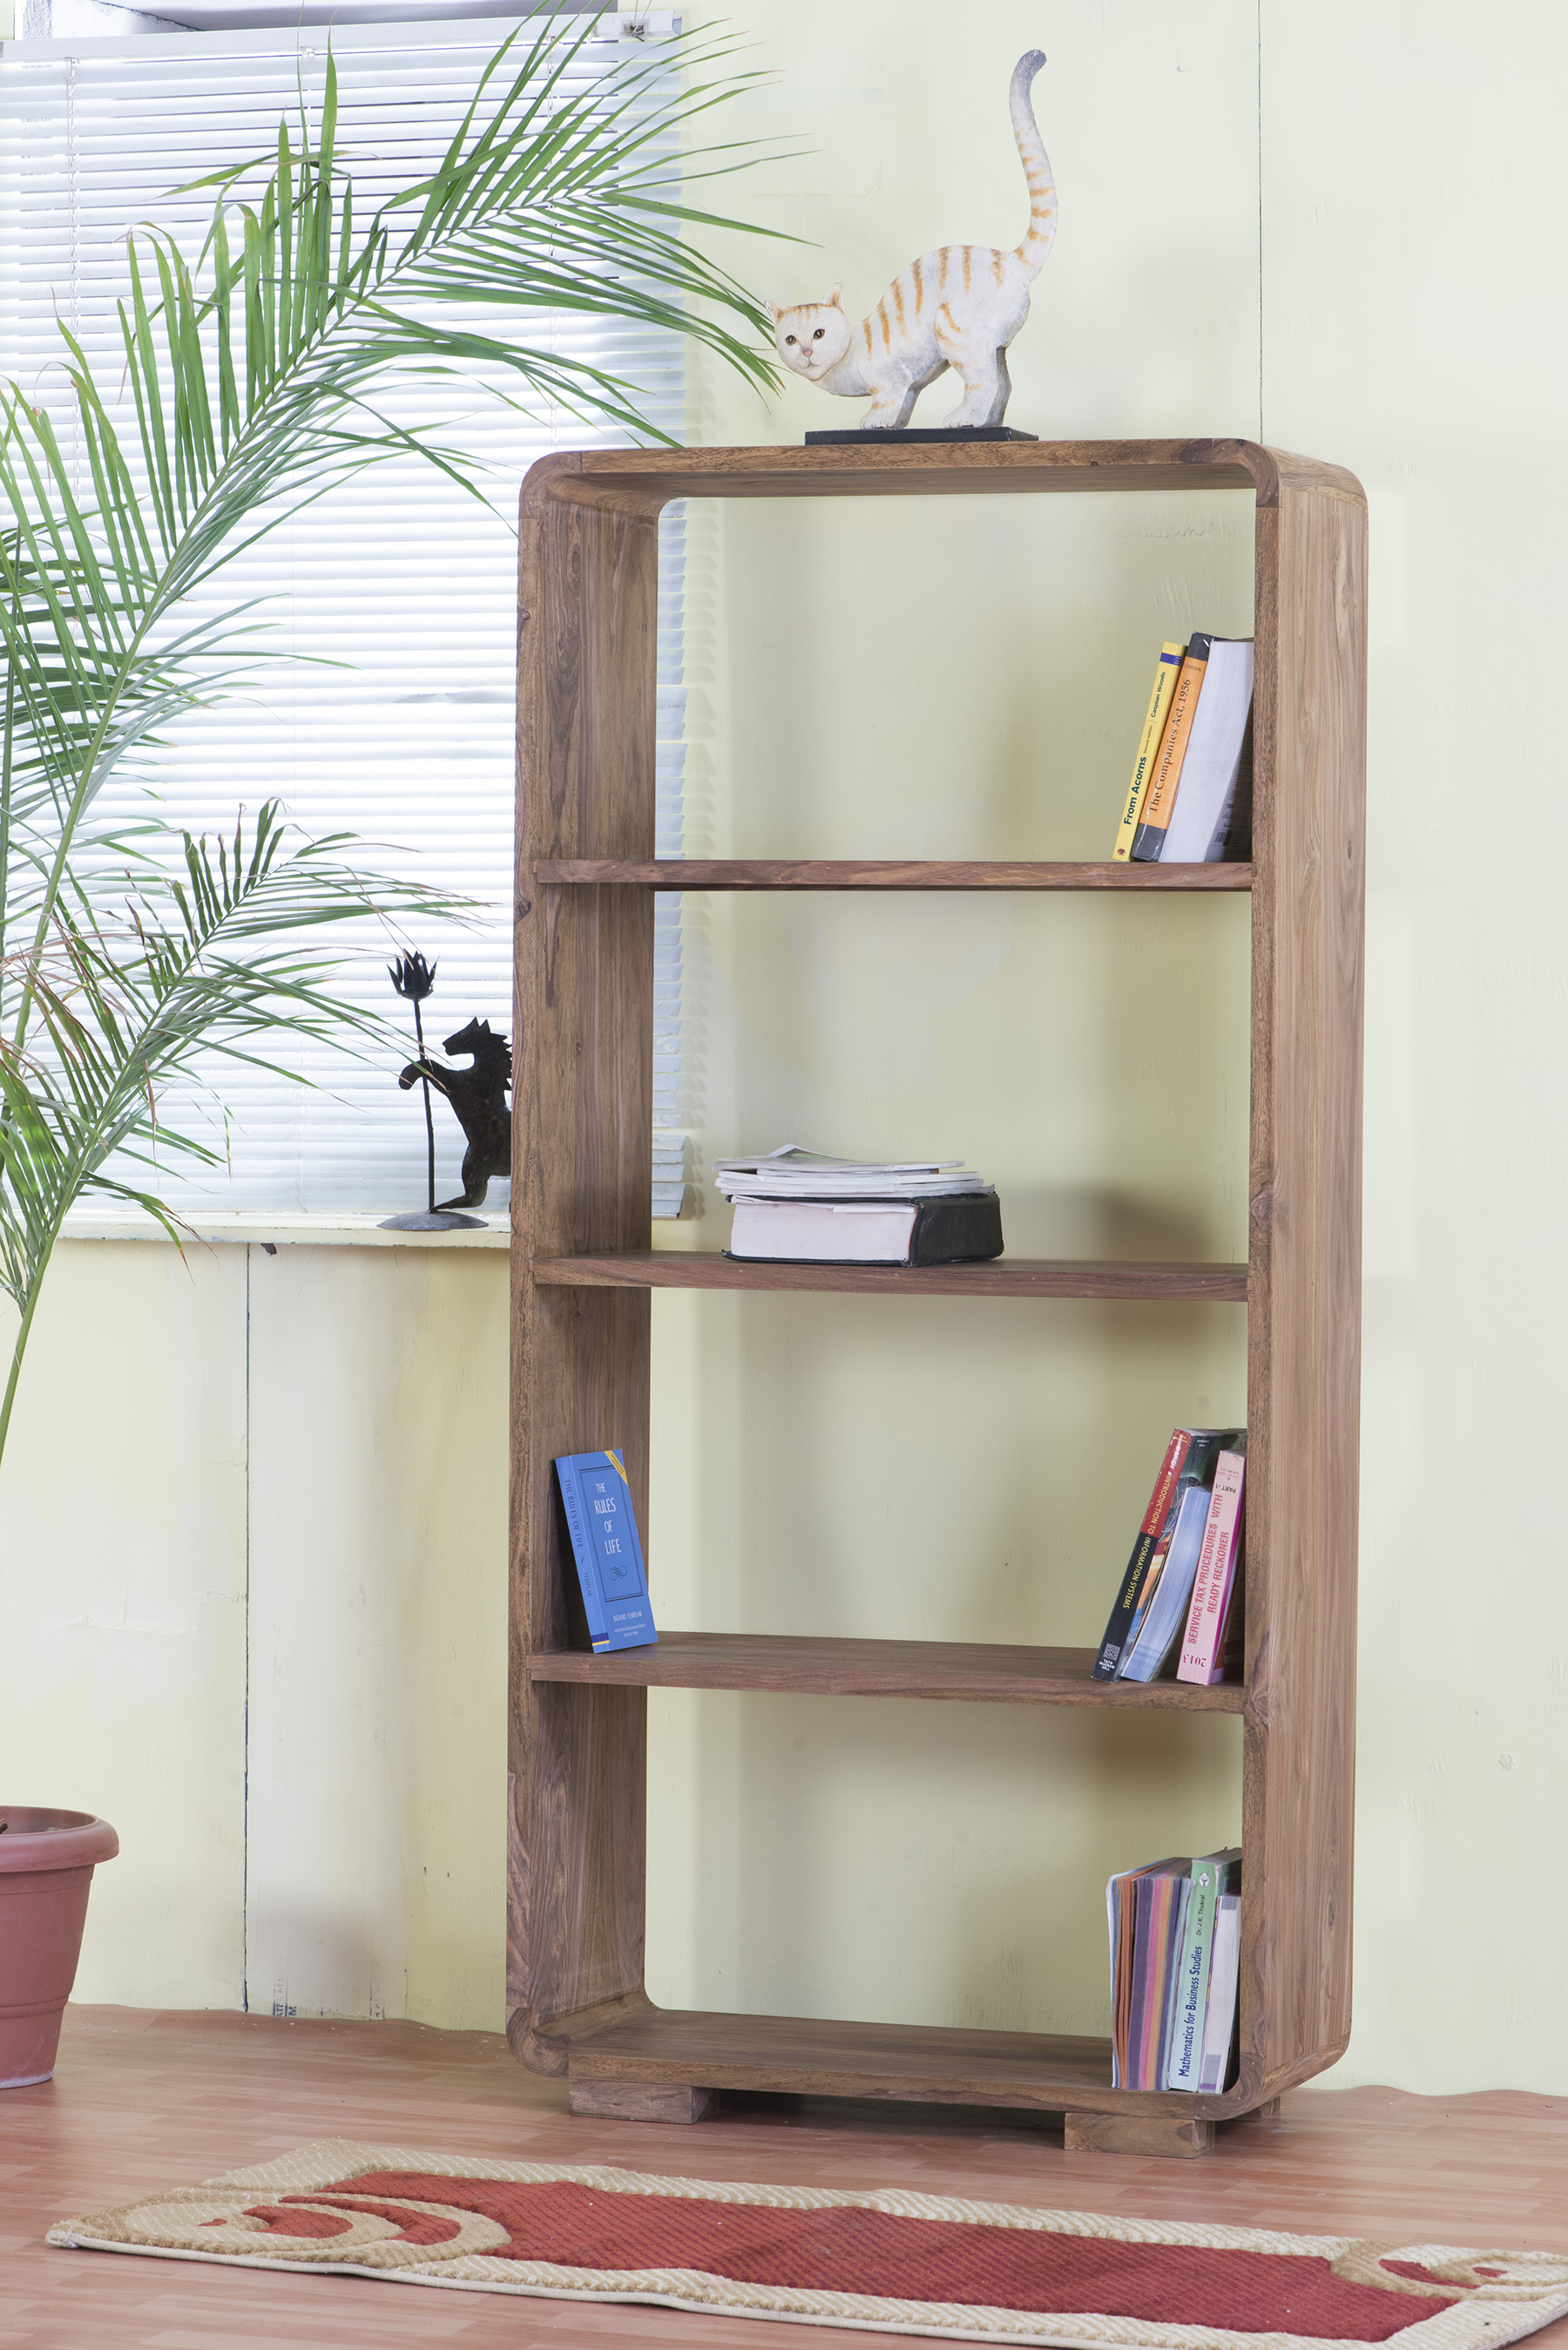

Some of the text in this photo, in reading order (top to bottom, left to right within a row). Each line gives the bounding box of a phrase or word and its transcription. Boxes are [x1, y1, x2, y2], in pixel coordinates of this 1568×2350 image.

[1151, 671, 1166, 718] Caspian Woods
[1149, 679, 1192, 813] The Companies Act, 1956
[1124, 756, 1147, 825] From Acorns
[596, 1483, 606, 1493] THE
[1221, 1485, 1236, 1493] PART
[568, 1495, 578, 1519] RULES
[594, 1498, 617, 1514] RULES
[573, 1520, 580, 1532] OF
[605, 1520, 613, 1533] OF
[575, 1533, 584, 1548] LIFE
[605, 1539, 622, 1554] LIFE
[1122, 1475, 1171, 1609] INTRODUCTION TO INFORMATION SYSTEMS
[1186, 1494, 1223, 1644] SERVICE TAX PROCEDURES WITH
[1206, 1531, 1229, 1614] READY RECKONER
[584, 1572, 592, 1597] TEMPLAR
[1183, 1652, 1207, 1668] 2013
[1179, 1946, 1203, 2077] Mathematics for Business Studies
